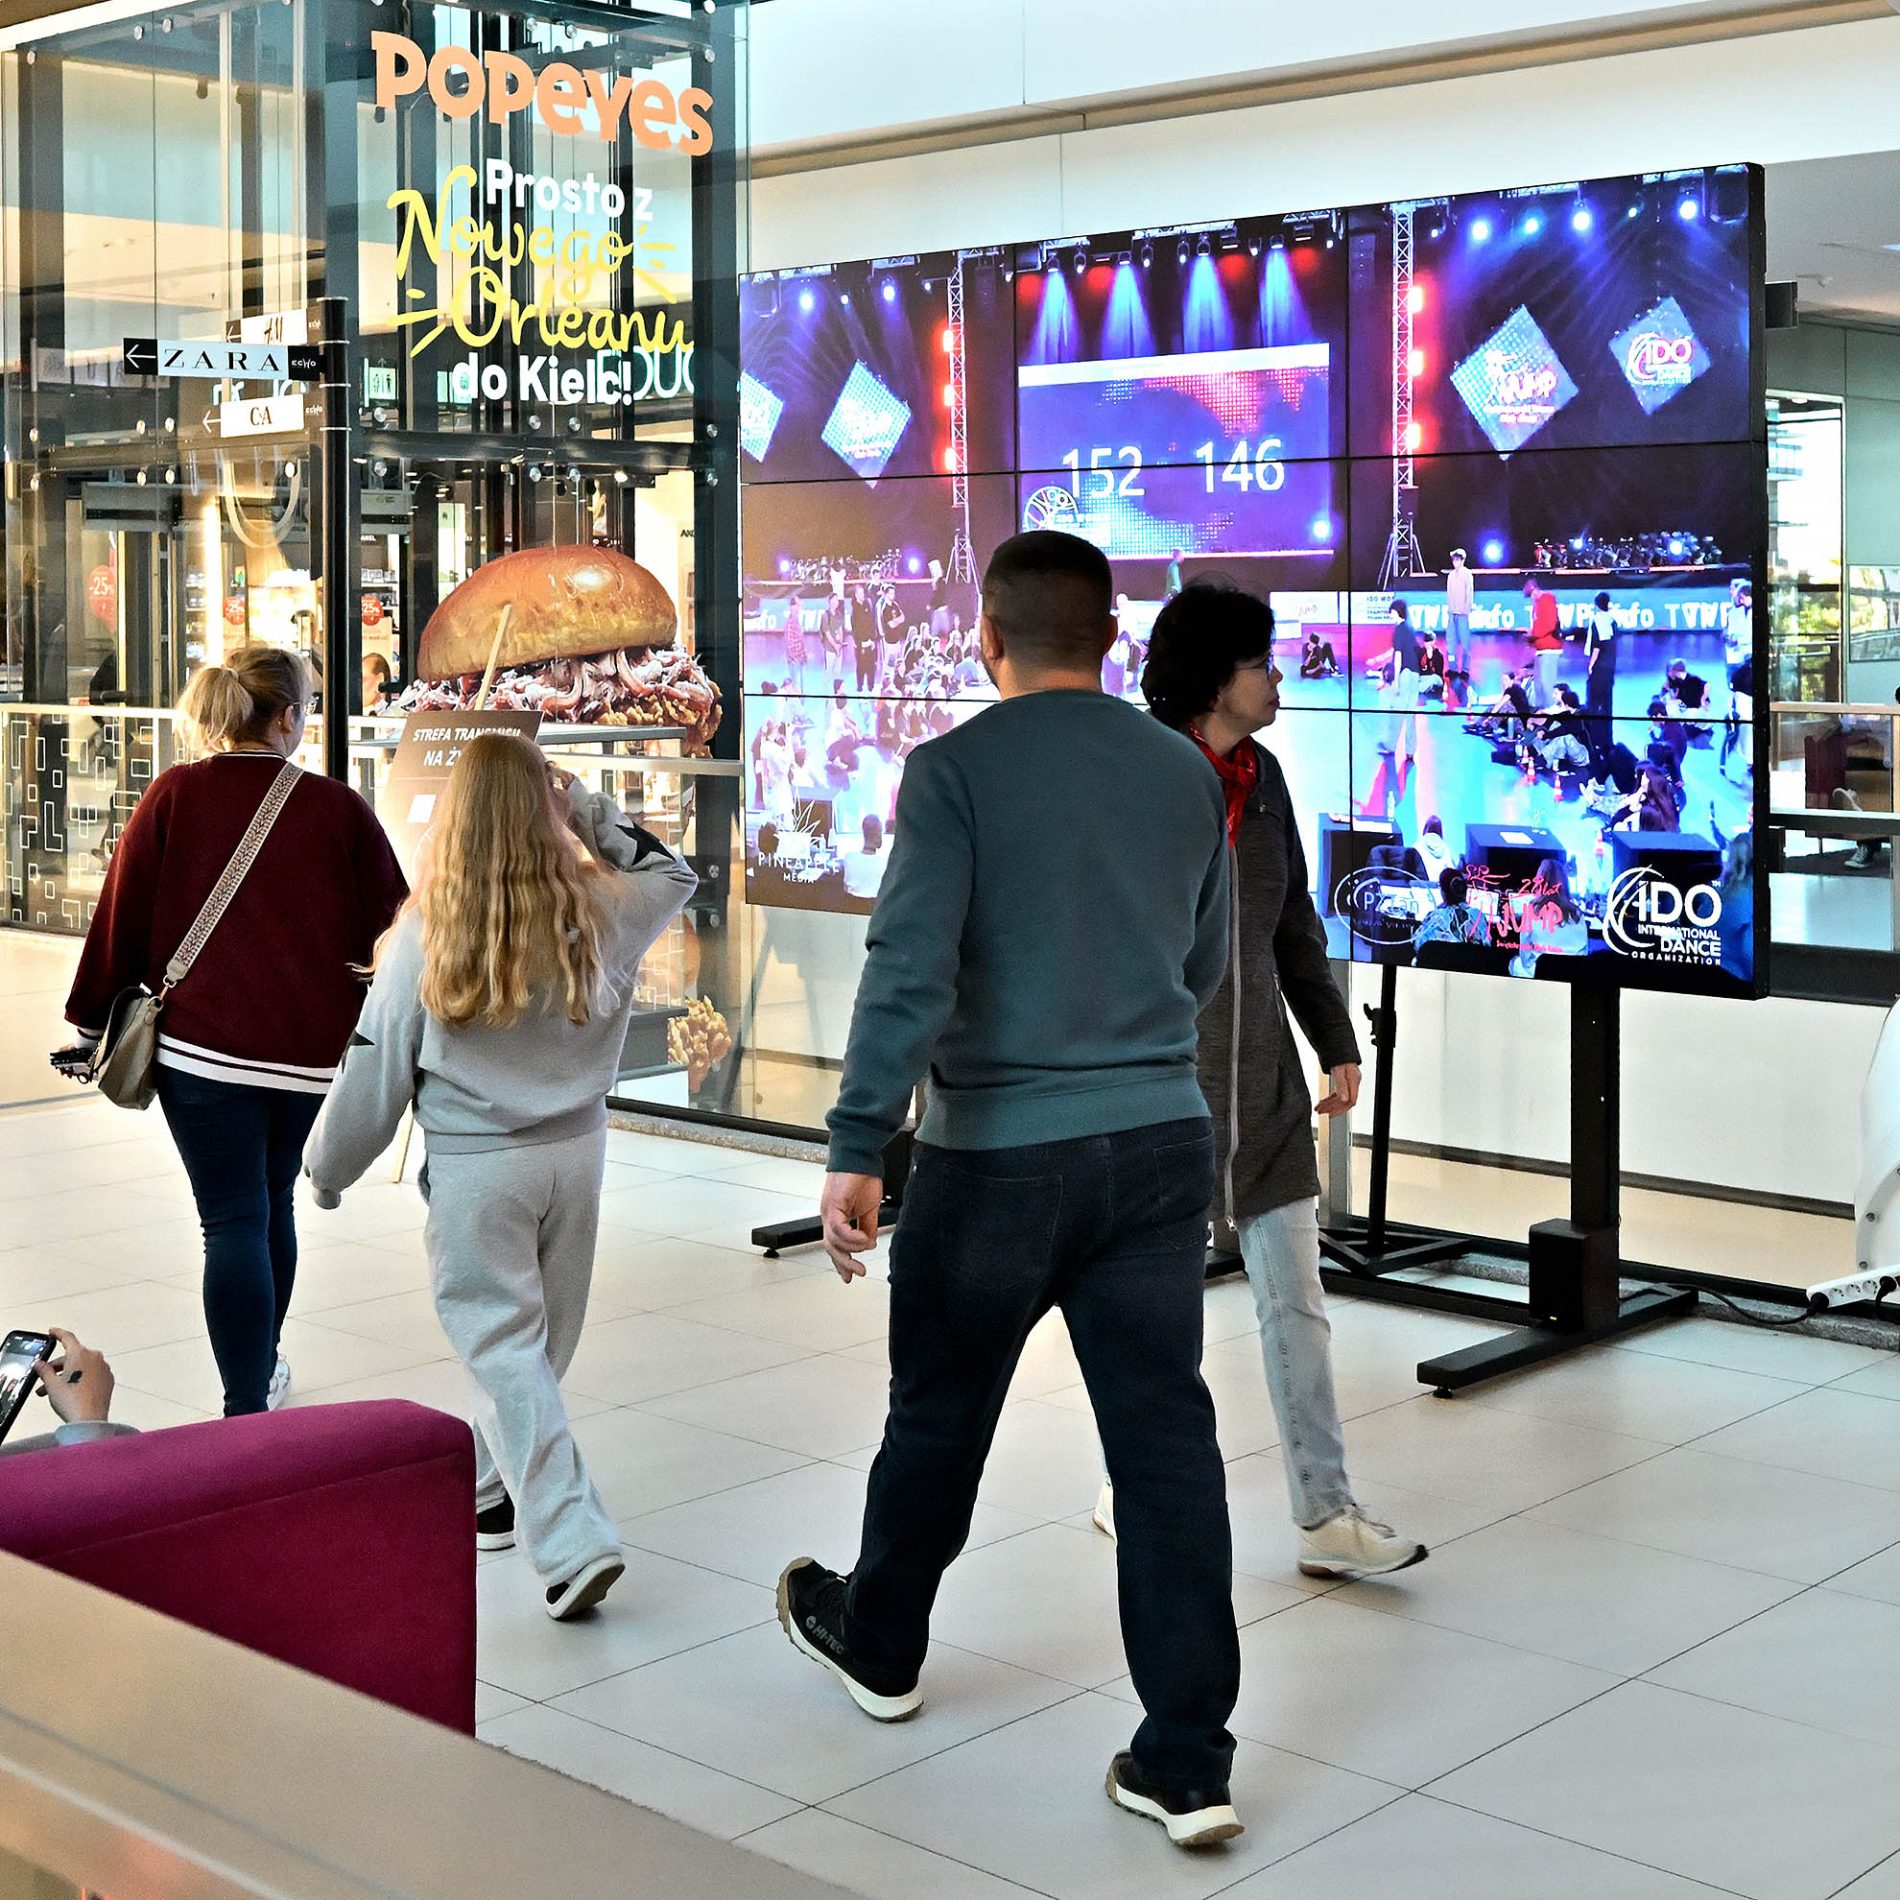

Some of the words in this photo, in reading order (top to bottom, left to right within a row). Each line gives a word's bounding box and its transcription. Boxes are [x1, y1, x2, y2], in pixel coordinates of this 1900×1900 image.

[486, 158, 625, 219] Prosto
[635, 187, 654, 221] z
[387, 165, 634, 300] Nowego
[451, 265, 695, 355] Orleanu
[164, 349, 281, 372] ZARA
[291, 357, 317, 370] ECHO
[451, 352, 507, 400] do
[518, 353, 633, 406] Kielc!
[1062, 445, 1146, 497] 152
[1196, 438, 1285, 493] 146
[413, 727, 452, 742] STREFA
[423, 750, 443, 767] NA
[1497, 900, 1563, 938] JUMP
[1638, 880, 1722, 928] IDO
[1637, 924, 1721, 941] INTATIONAL
[1660, 936, 1721, 957] DANCE
[1631, 951, 1721, 966] ORGANIZATION
